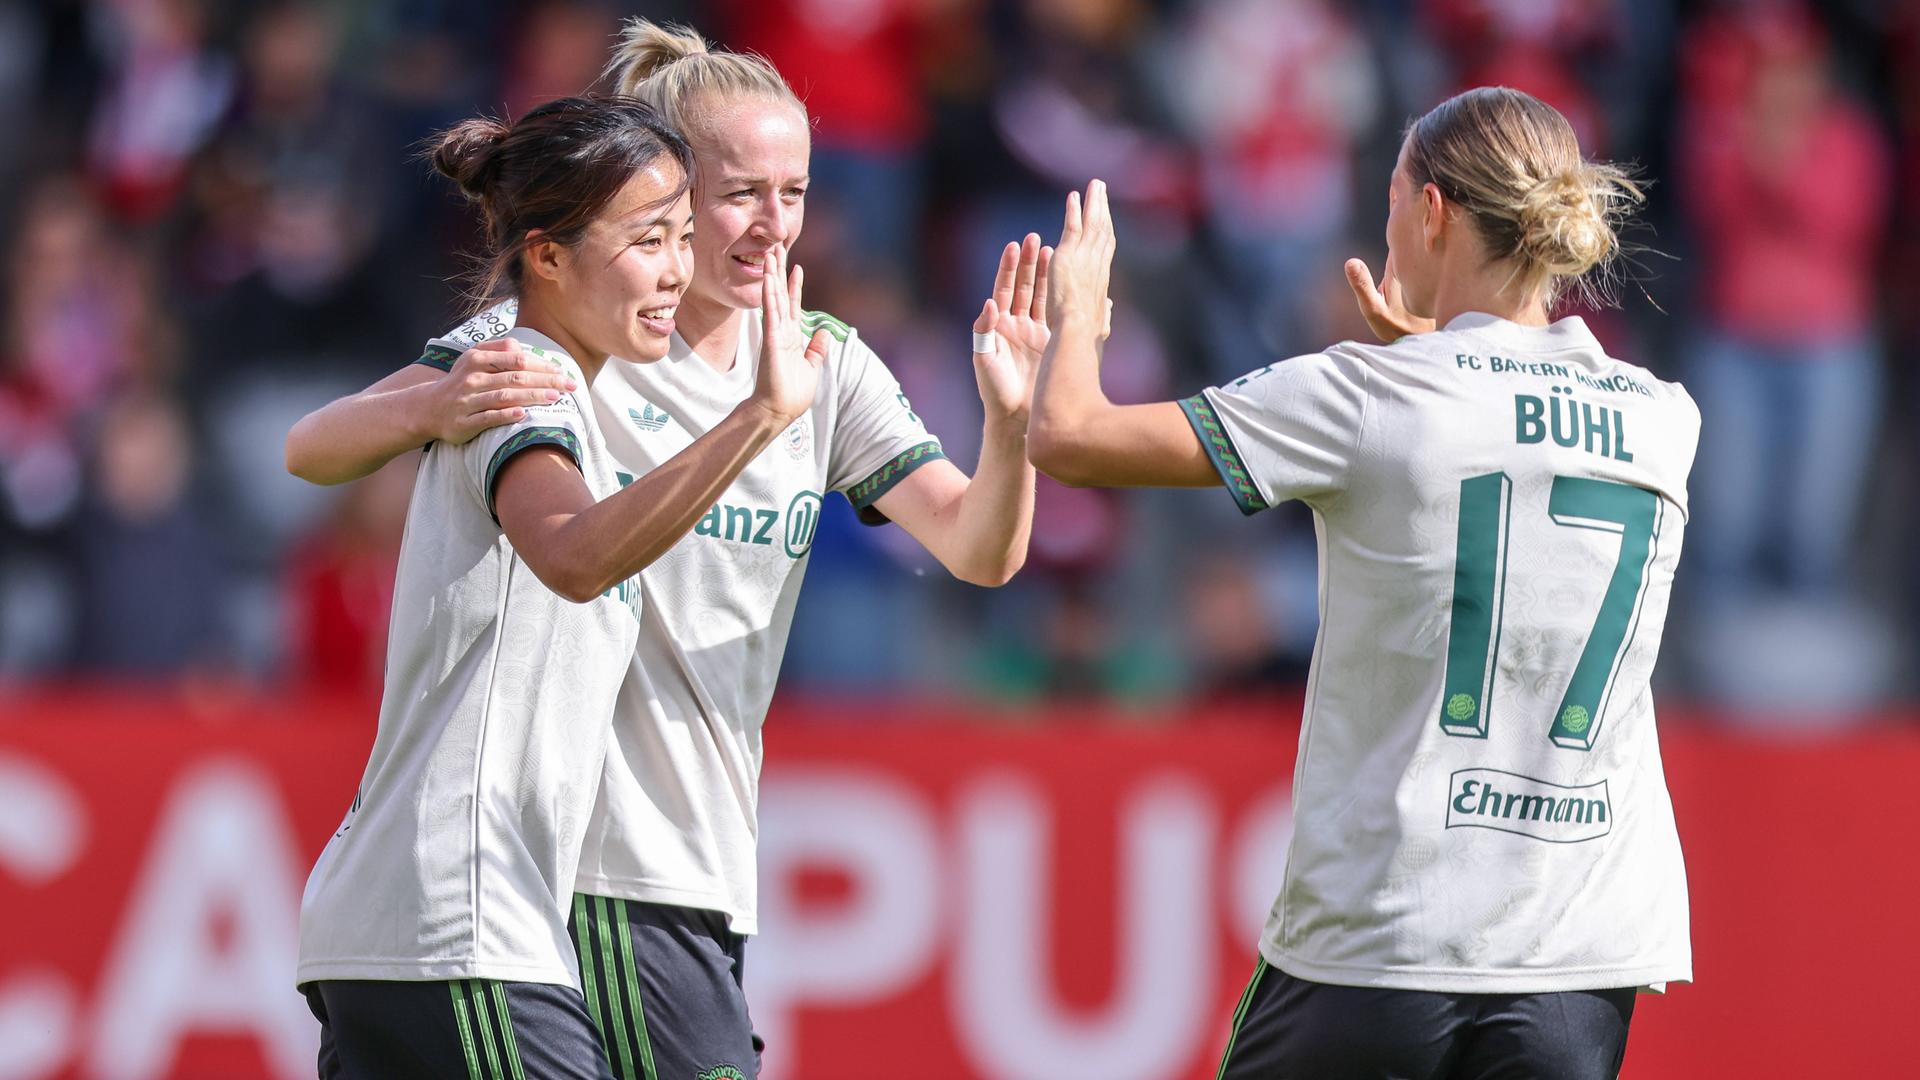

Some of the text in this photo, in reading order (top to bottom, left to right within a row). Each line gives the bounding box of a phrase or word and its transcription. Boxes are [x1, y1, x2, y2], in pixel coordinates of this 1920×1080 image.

[1455, 354, 1655, 400] FC BAYERN MÜNCHEN
[1514, 386, 1634, 463] BÜHL
[1439, 471, 1664, 751] 17
[1453, 779, 1606, 824] Ehrmann
